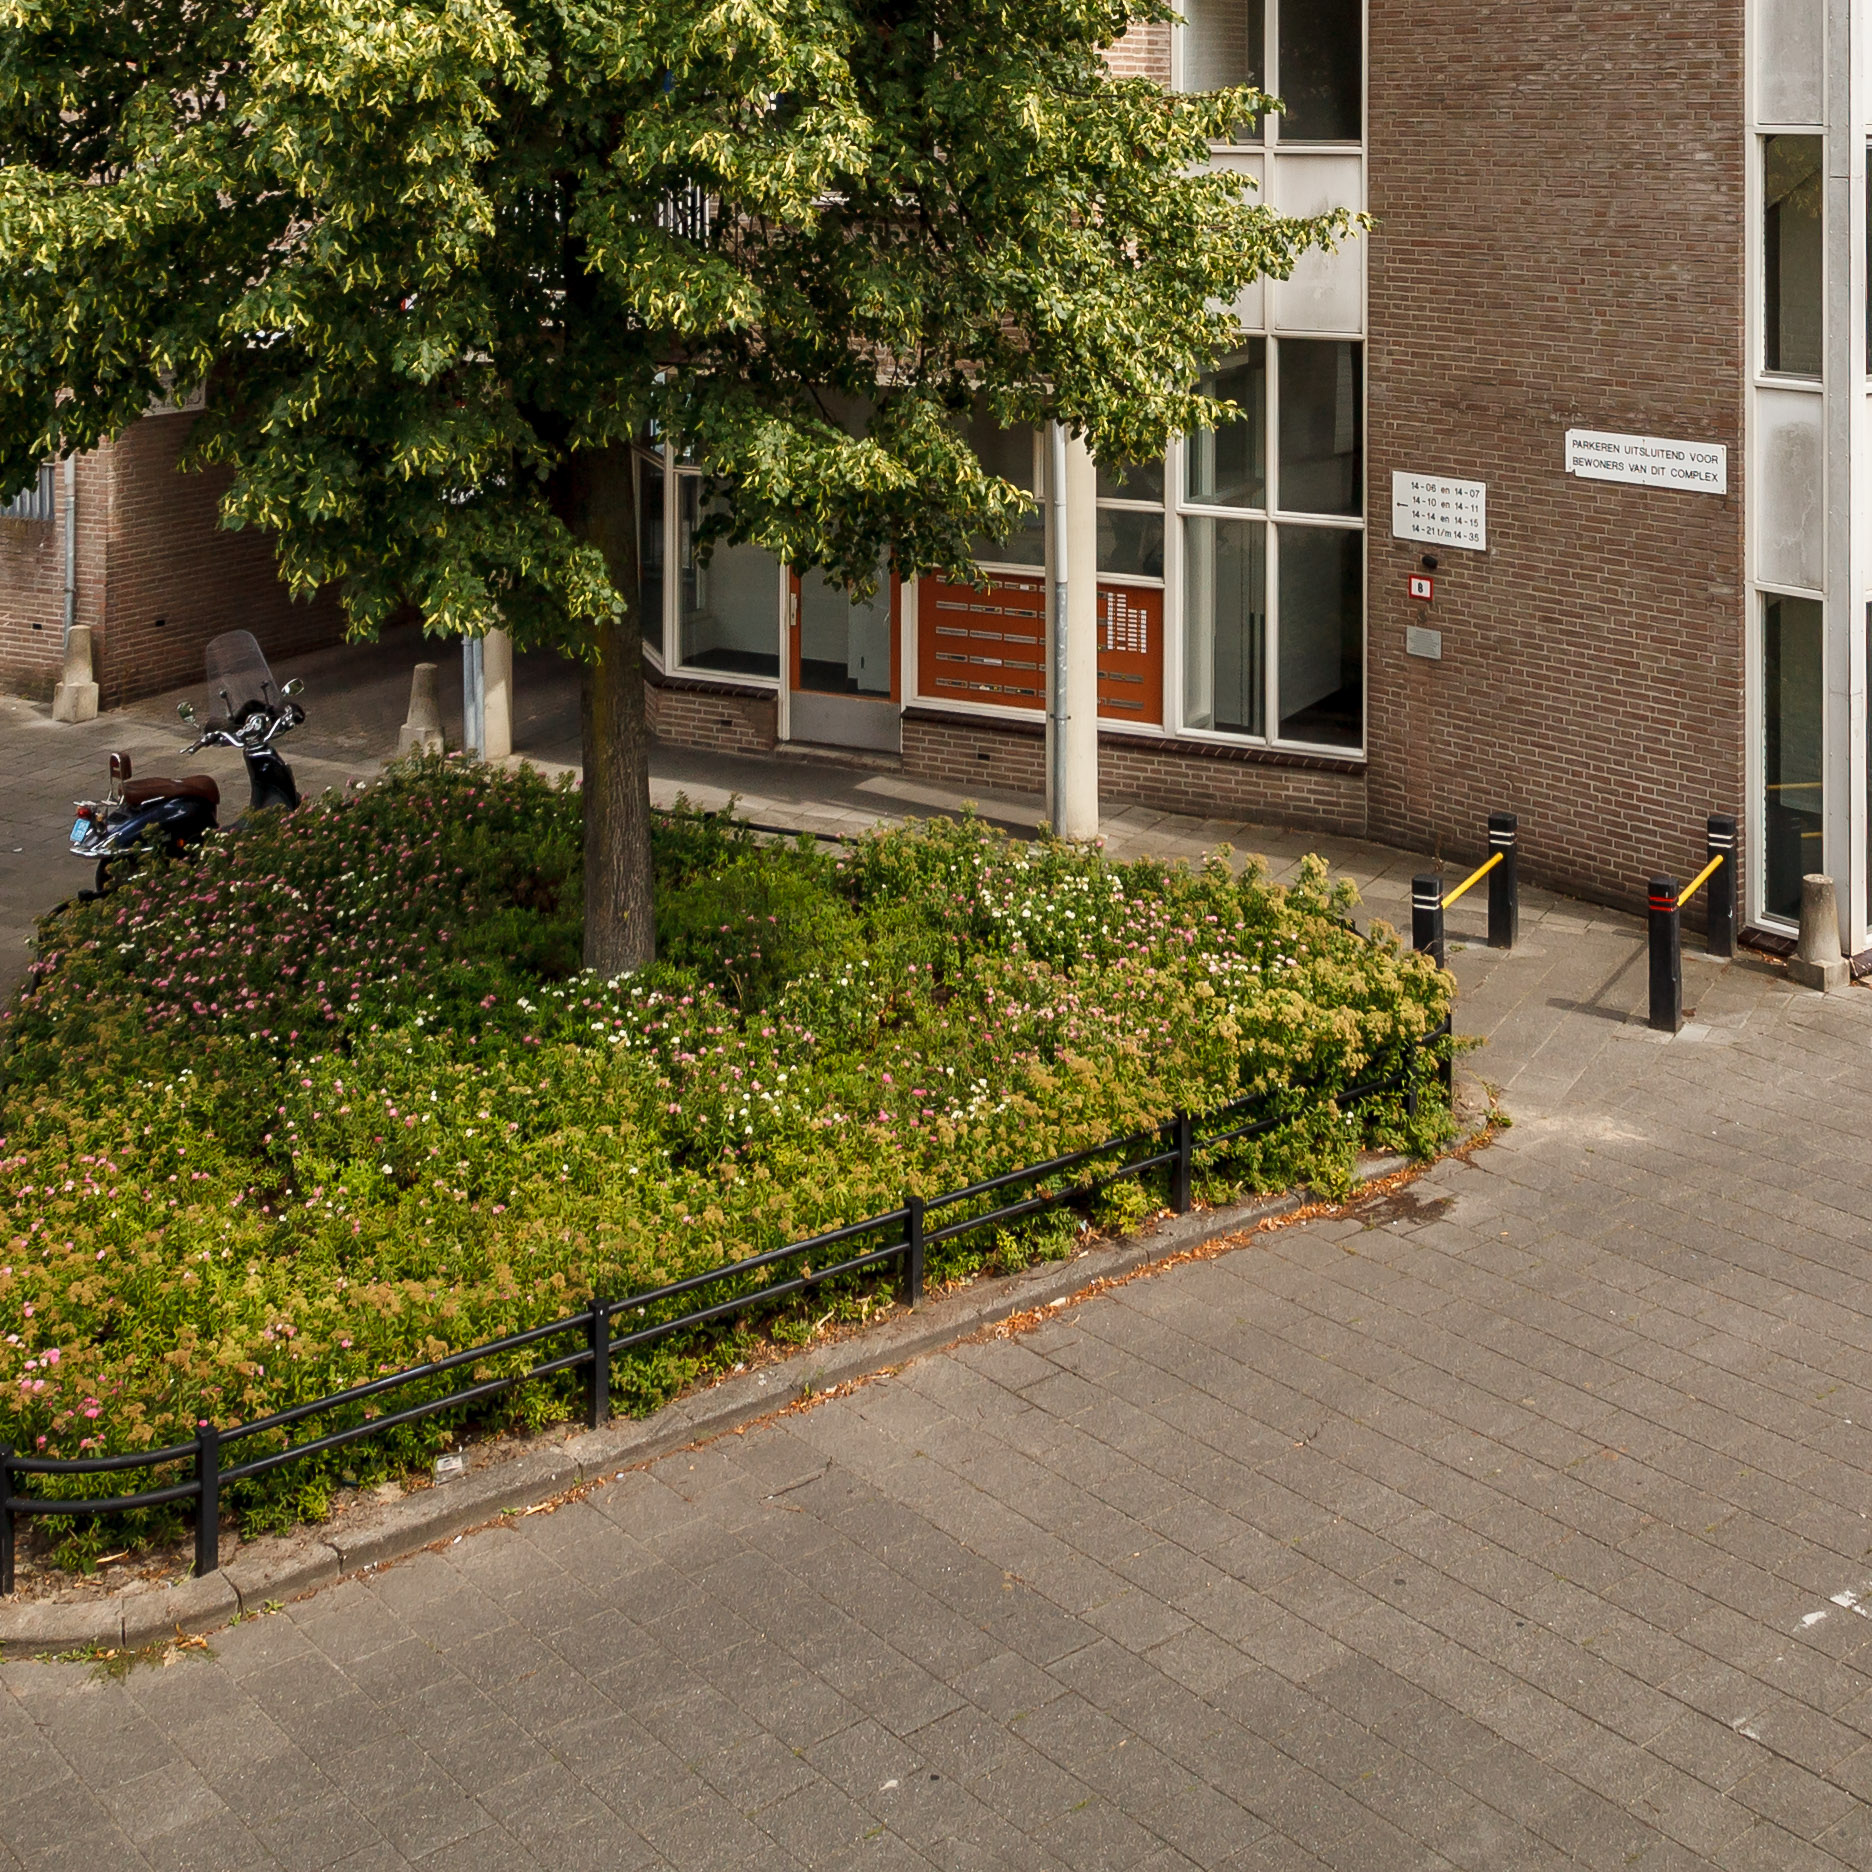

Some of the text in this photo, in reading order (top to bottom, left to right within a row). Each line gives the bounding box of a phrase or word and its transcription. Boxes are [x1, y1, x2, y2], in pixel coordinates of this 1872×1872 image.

[1572, 439, 1719, 464] PARKEREN UITSLUITEND VOOR
[1572, 456, 1719, 482] BEWONERS VAN DIT COMPLEX
[1440, 515, 1450, 523] en
[1437, 528, 1451, 538] t/m
